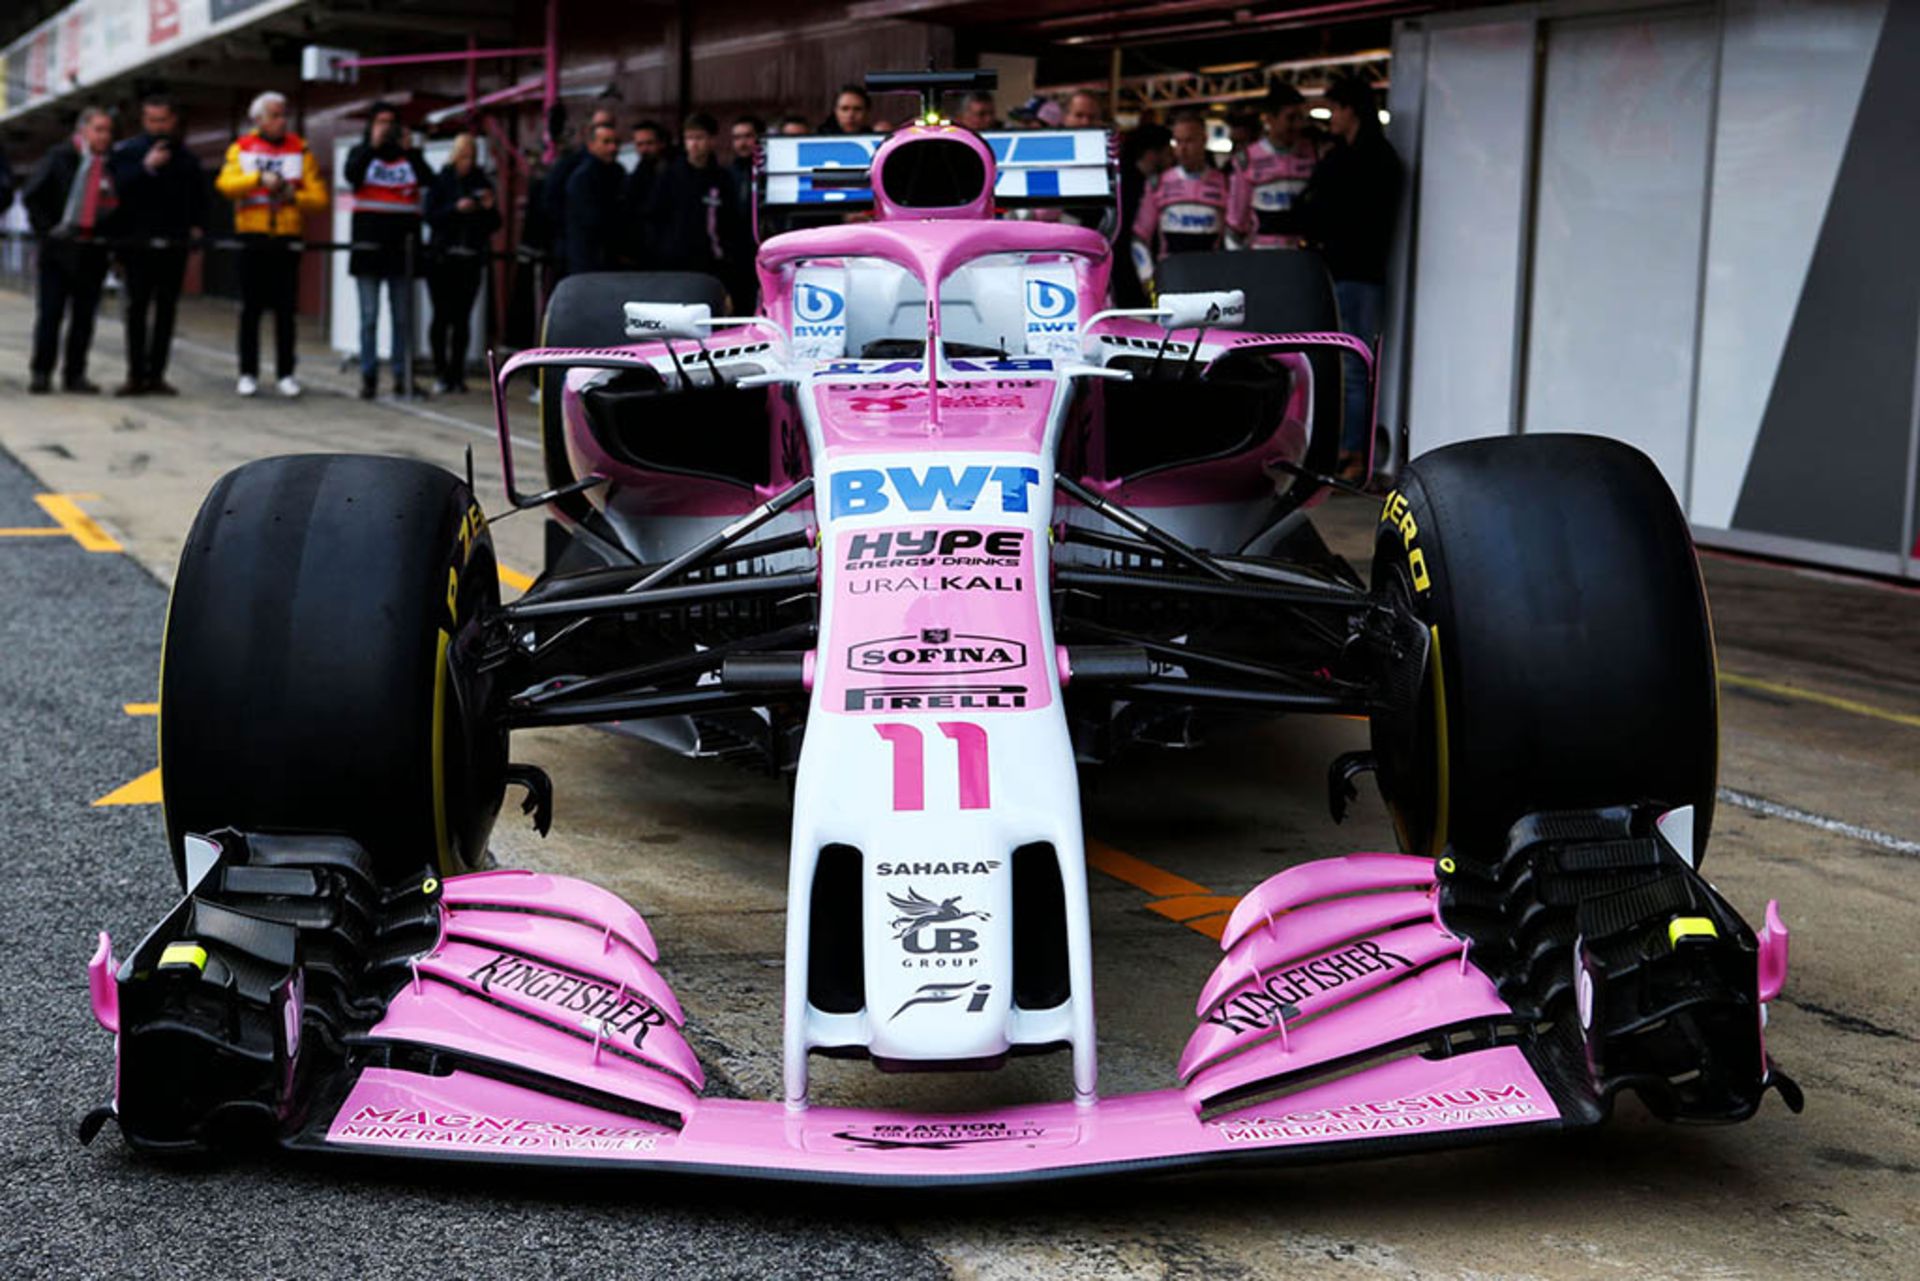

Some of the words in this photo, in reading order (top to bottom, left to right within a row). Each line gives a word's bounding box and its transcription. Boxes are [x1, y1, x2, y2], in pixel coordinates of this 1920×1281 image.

[794, 325, 846, 337] BWT
[1027, 321, 1077, 333] BWT
[830, 465, 1040, 521] BWT
[847, 529, 1025, 560] HYPE
[1380, 490, 1431, 592] ZERO
[845, 558, 936, 571] ENERGY
[941, 556, 1021, 568] DRINKS
[849, 576, 1023, 593] URALKALI
[862, 646, 1015, 665] SOFINA
[844, 685, 1029, 712] PIRELLI
[873, 721, 991, 811] 11
[876, 860, 1000, 876] SAHARA
[901, 928, 980, 954] UB
[901, 957, 979, 969] GROUP
[1206, 940, 1415, 1036] KINGFISHER
[468, 953, 667, 1050] KINGFISHER
[905, 1130, 963, 1140] ROAD
[966, 1127, 1047, 1138] SAFETY
[912, 1122, 1007, 1133] ACTION
[1221, 1114, 1427, 1143] MINERALIZED
[1438, 1101, 1542, 1123] WATER
[341, 1123, 542, 1147] MINERALIZED
[549, 1136, 658, 1152] WATER
